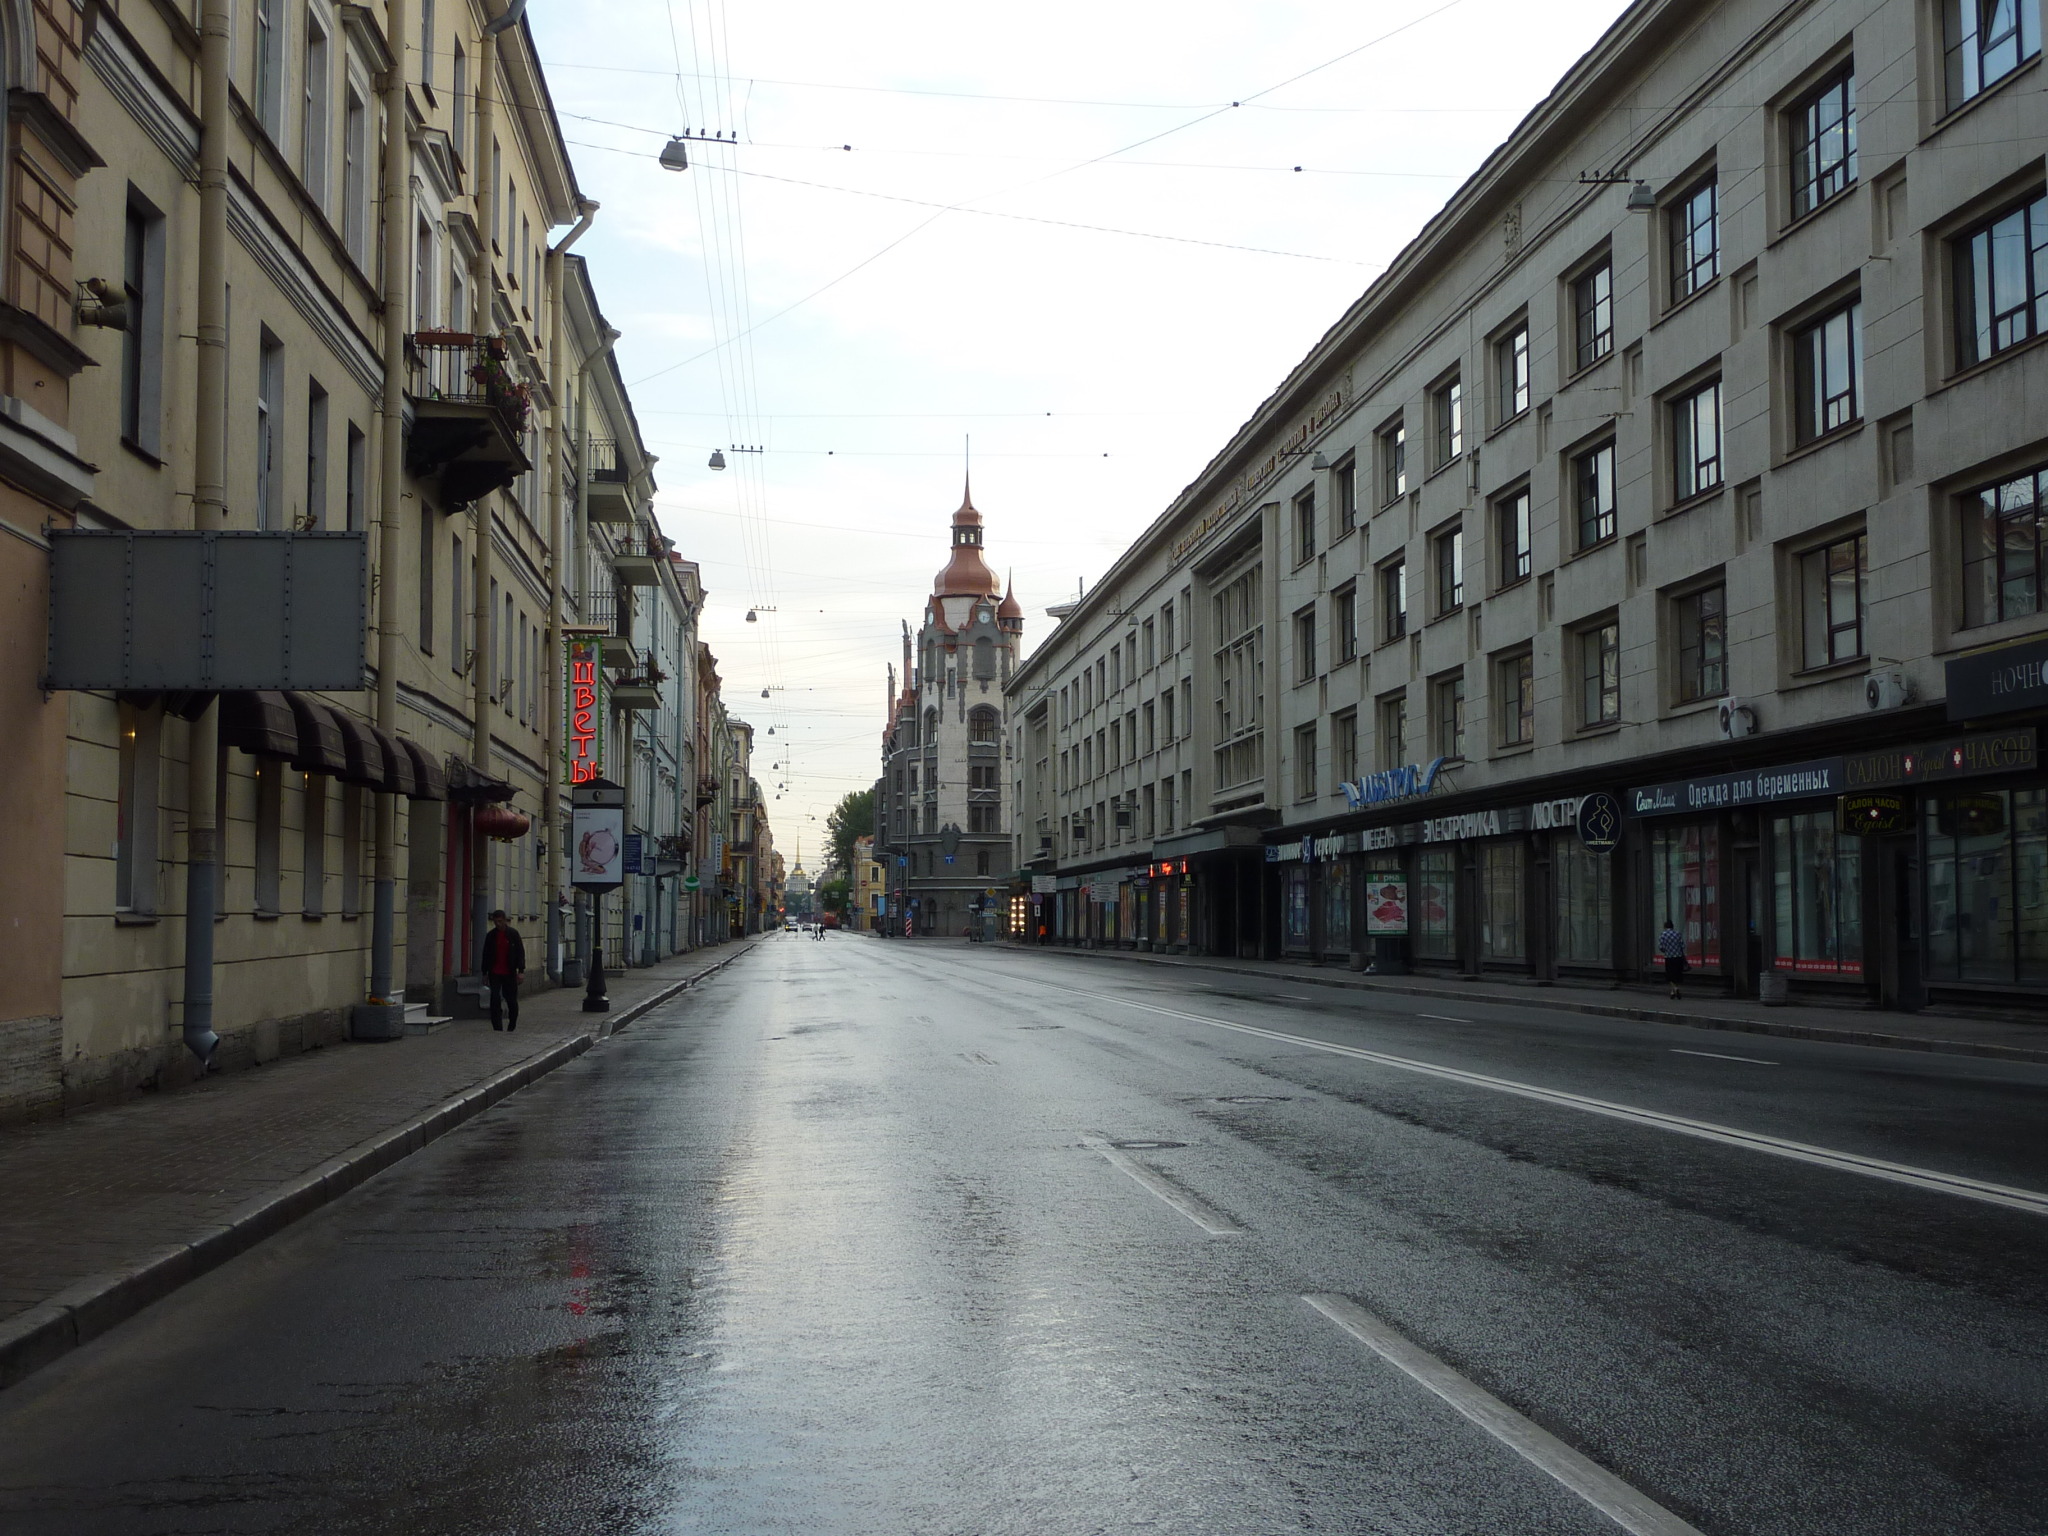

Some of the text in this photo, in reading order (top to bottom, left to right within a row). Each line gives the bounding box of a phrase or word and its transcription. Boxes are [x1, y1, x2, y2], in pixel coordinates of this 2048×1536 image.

[1847, 754, 1902, 785] САЛОН
[1965, 735, 2032, 769] ЧАСОВ
[1360, 764, 1420, 804] АЛЬБАТРОС
[1688, 769, 1830, 808] Одежда для беременных
[1531, 797, 1583, 831] ЛЮСТР
[1847, 797, 1900, 811] САЛОН ЧАСОВ
[1363, 826, 1395, 851] МЕБЕЛЬ
[1423, 809, 1501, 843] ЭЛЕКТРОНИКА
[1685, 886, 1715, 905] СКИКИ
